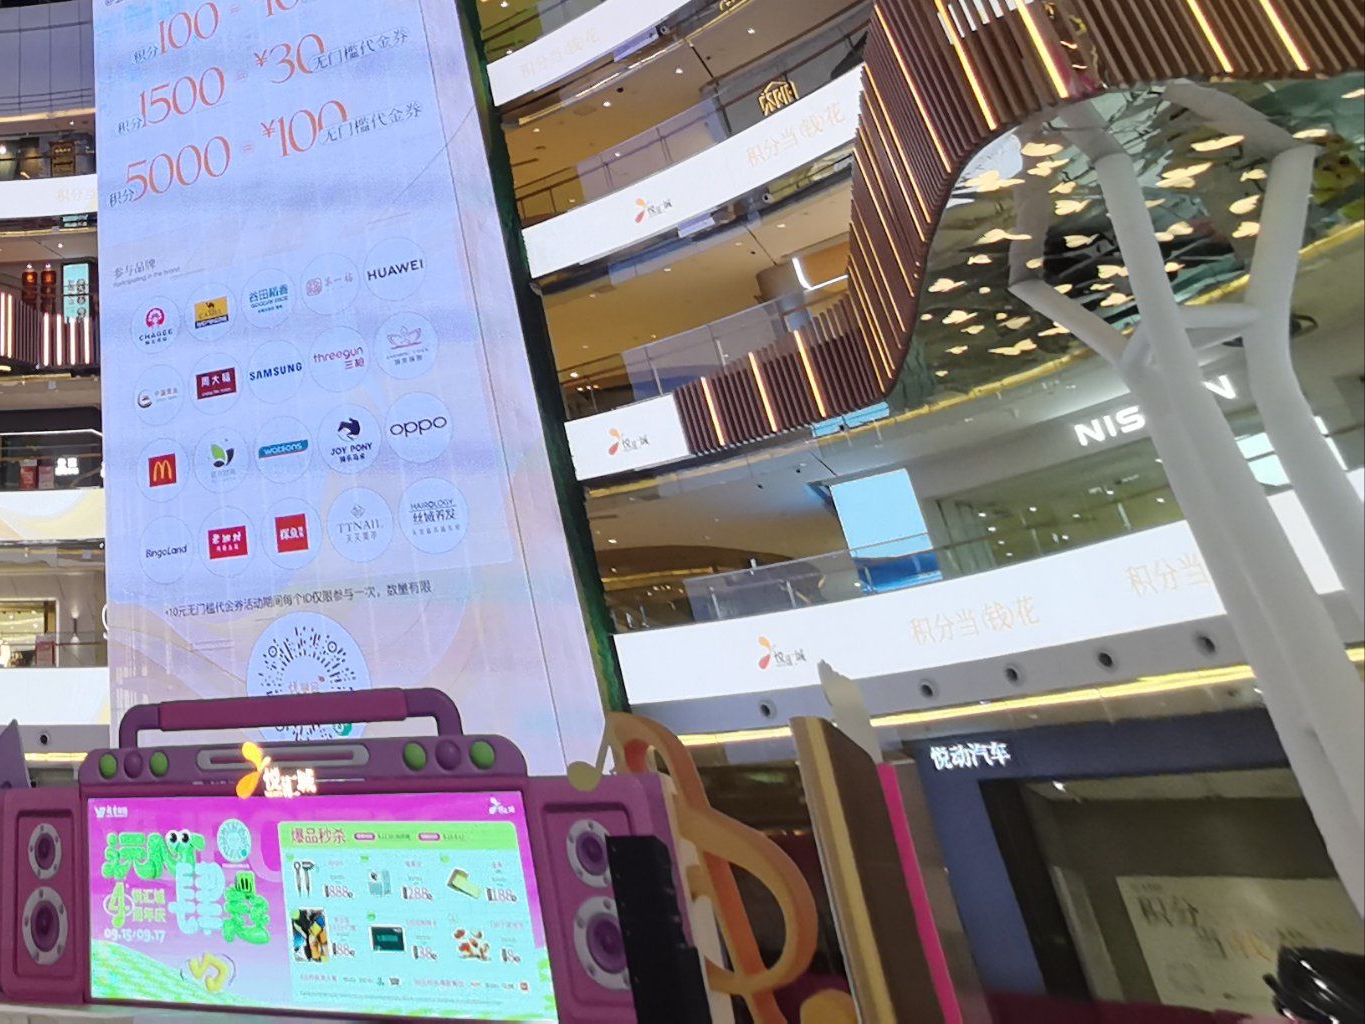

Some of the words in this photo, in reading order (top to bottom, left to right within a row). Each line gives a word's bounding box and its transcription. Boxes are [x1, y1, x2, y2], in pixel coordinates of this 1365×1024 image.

[159, 2, 220, 55] 100
[139, 67, 226, 127] 1500
[126, 135, 231, 202] 5000
[367, 259, 424, 281] HUAWEI
[314, 347, 364, 364] threegun
[249, 362, 302, 381] SAMSUNG
[1074, 374, 1237, 446] NISN
[330, 446, 347, 456] JOY
[350, 442, 373, 453] PONY
[930, 741, 1011, 771] 悦动汽车
